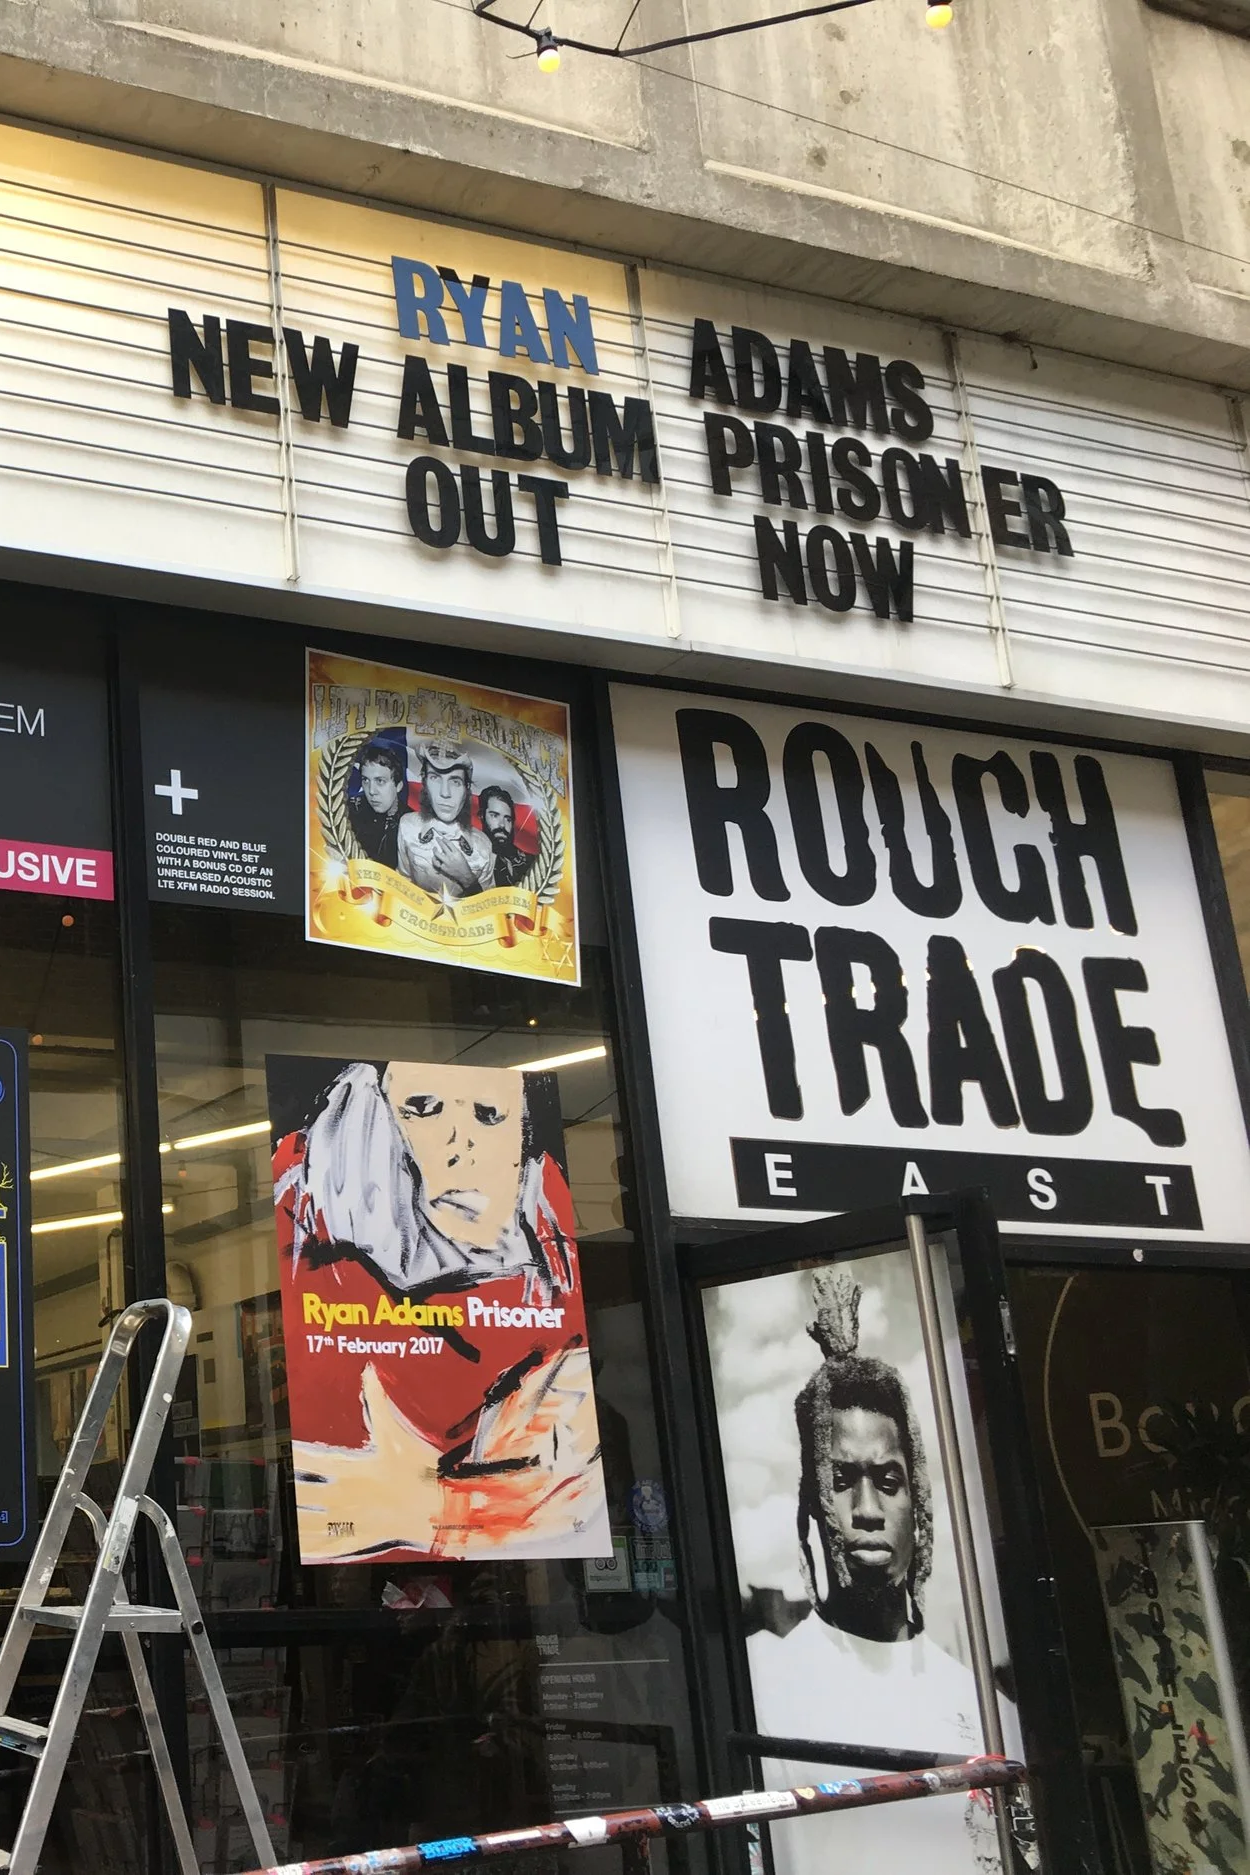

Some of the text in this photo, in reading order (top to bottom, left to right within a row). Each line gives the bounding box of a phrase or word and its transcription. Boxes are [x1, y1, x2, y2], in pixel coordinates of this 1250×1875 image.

[391, 255, 935, 443] RYAN ADAMS
[168, 308, 1075, 558] NEW ALBUM PRISONER
[405, 456, 914, 624] OUT NOW
[675, 707, 1138, 937] ROUGH
[155, 832, 267, 853] DOUBLE RED AND BLUE
[156, 844, 259, 863] COLOURED VINYL SET
[157, 856, 273, 876] WITH A BONUS CD OF AN
[157, 867, 272, 888] UNRELEASED ACOUSTIC
[158, 879, 276, 900] LTE XFM RADIO SESSION.
[399, 908, 495, 940] CROSSROADS
[708, 915, 1188, 1148] TRADE
[303, 1293, 565, 1332] Ryan Adams Prisoner
[306, 1335, 444, 1358] 17th February 2017
